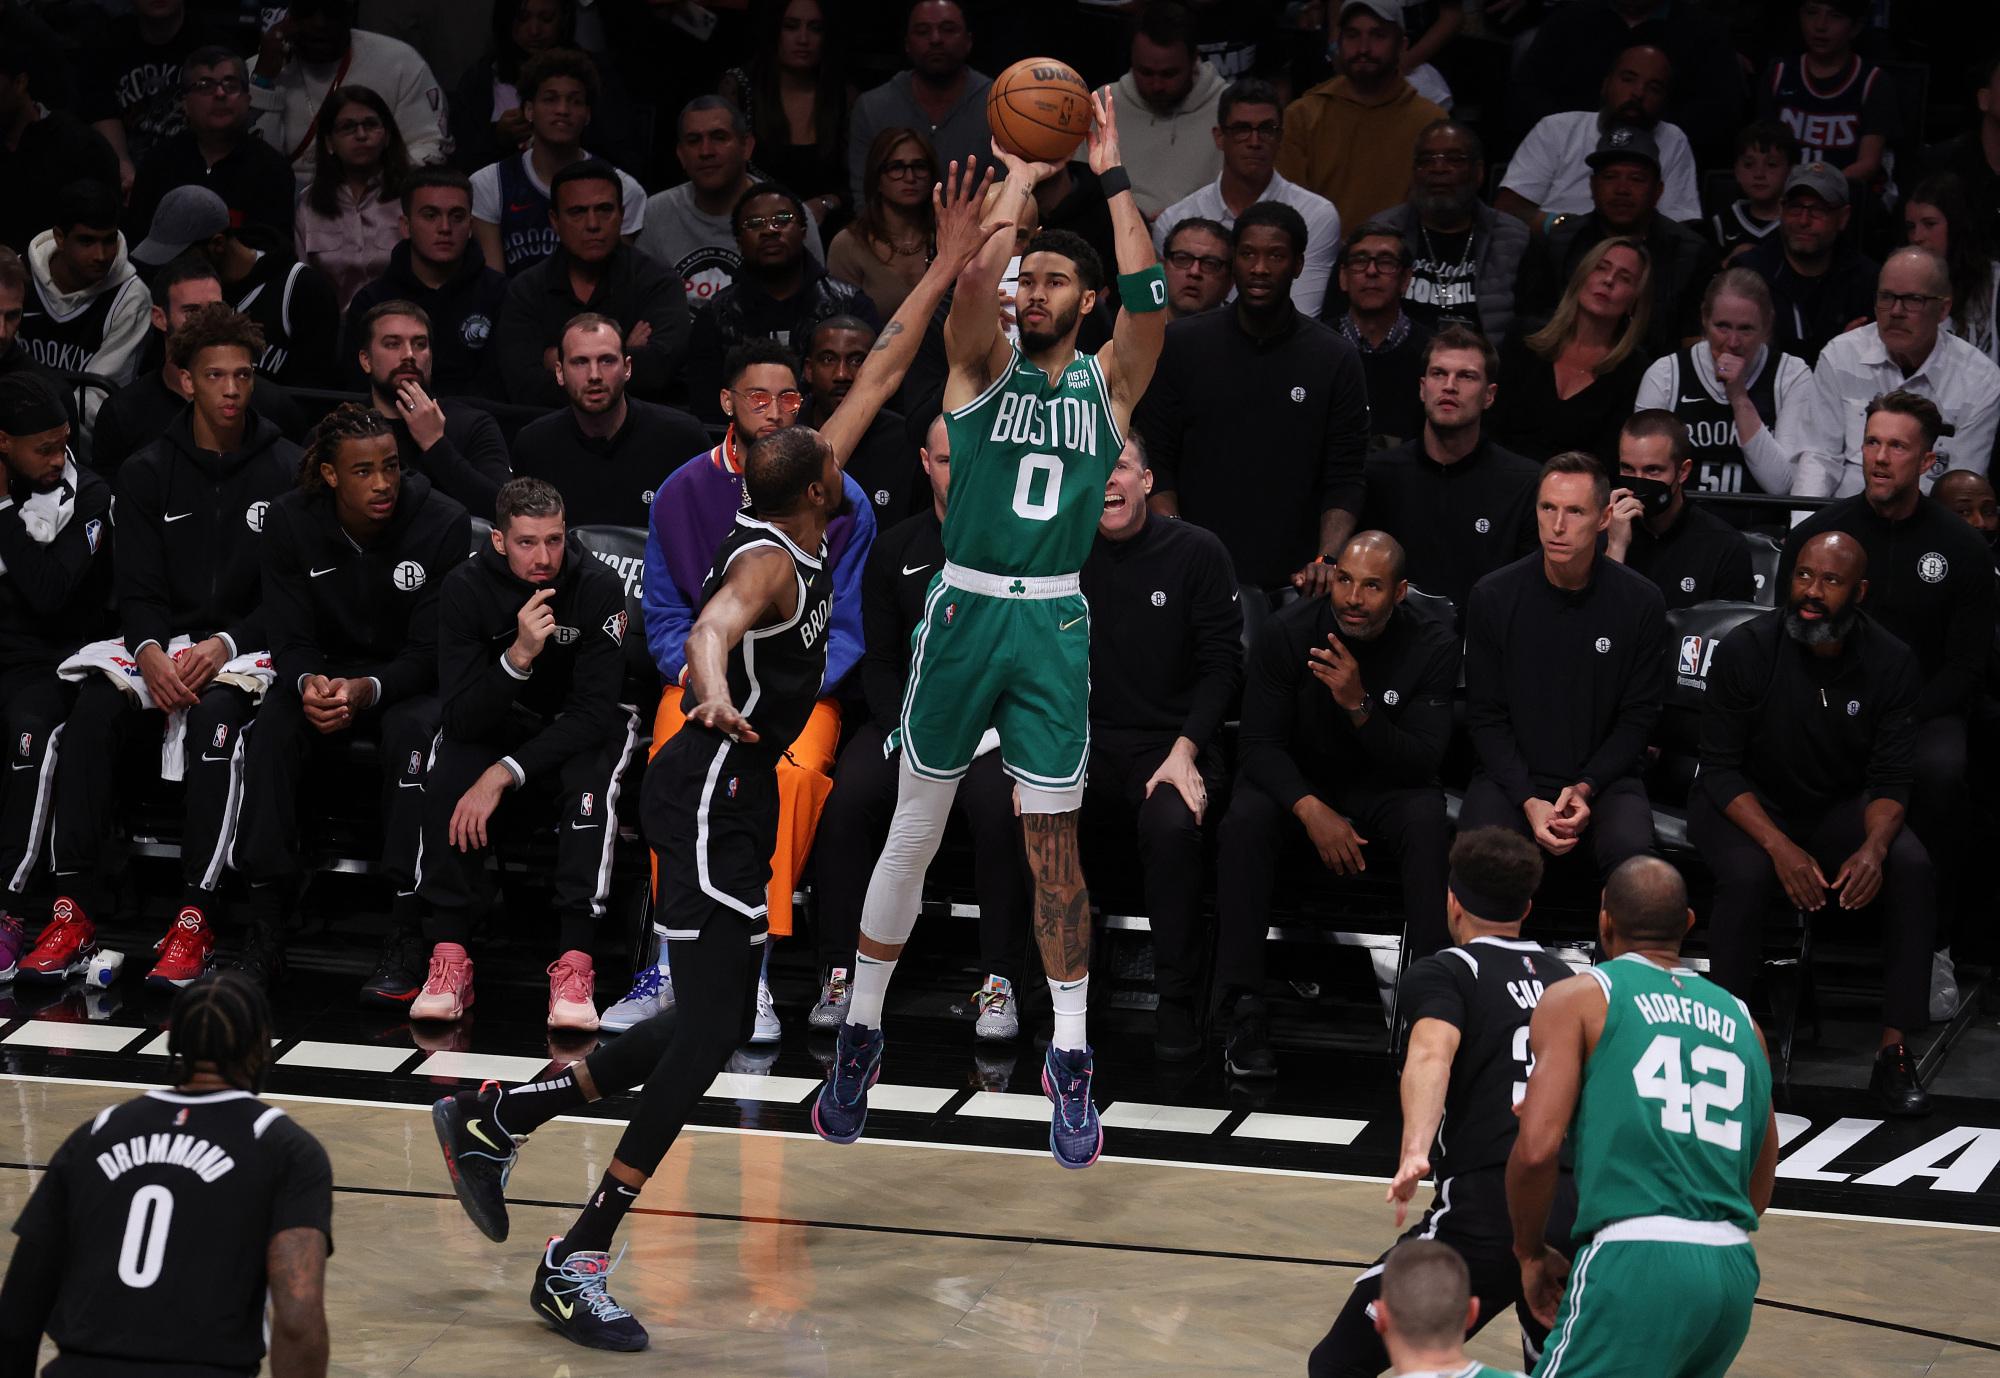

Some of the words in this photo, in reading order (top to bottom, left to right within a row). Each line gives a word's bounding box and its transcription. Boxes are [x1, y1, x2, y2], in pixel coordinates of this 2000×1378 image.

[1780, 107, 1858, 146] NETS
[1150, 280, 1164, 304] 0
[1066, 369, 1089, 382] VISTA
[1068, 380, 1091, 390] PRINT
[990, 391, 1097, 456] BOSTON
[1012, 452, 1064, 521] 0
[1698, 461, 1743, 490] 50
[1634, 992, 1736, 1044] HORFORD
[1632, 1034, 1745, 1151] 42
[96, 1133, 235, 1183] DRUMMOND
[118, 1184, 174, 1288] 0
